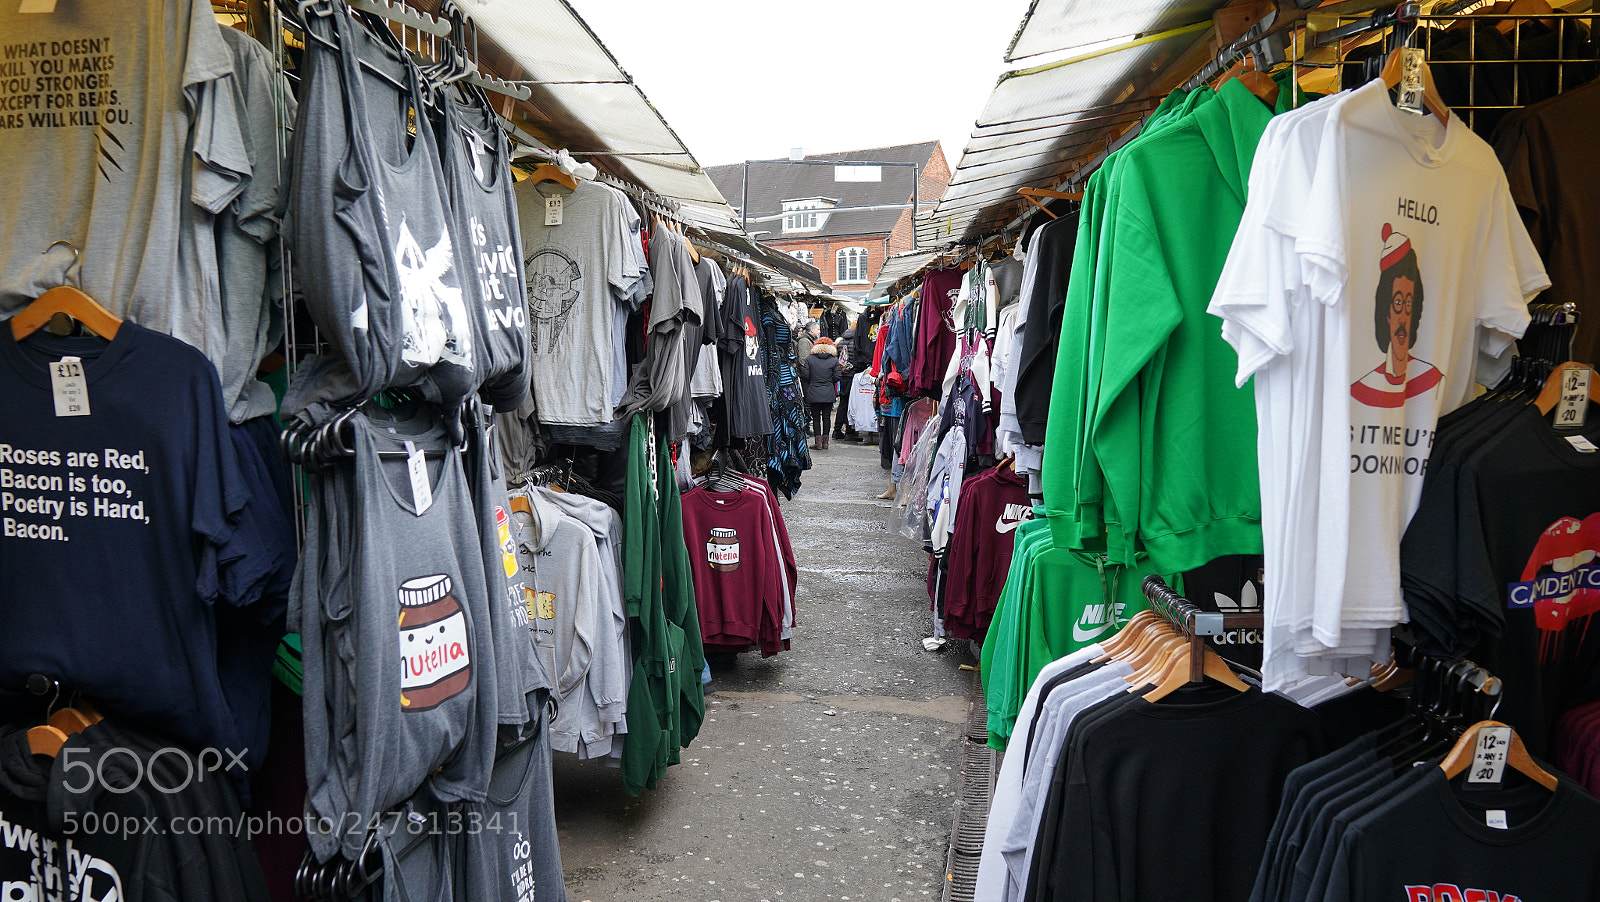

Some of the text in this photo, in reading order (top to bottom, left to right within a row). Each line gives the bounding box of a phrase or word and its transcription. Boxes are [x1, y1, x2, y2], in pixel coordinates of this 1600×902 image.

[4, 38, 110, 59] WHAT DOESN'T
[0, 55, 114, 77] KILL YOU MAKES
[1, 73, 113, 94] YOU STRONGER.
[46, 93, 74, 109] FOR
[28, 112, 66, 128] WILL
[69, 110, 101, 126] KILL
[102, 108, 133, 125] OU.
[1397, 196, 1440, 226] HELLO.
[57, 364, 80, 378] £12
[1360, 425, 1380, 445] IT
[1383, 426, 1402, 446] ME
[0, 443, 150, 475] Roses are Red,
[0, 468, 132, 499] Bacon is too,
[1, 491, 150, 525] Poetry is Hard,
[1002, 503, 1033, 521] NIKE
[3, 517, 69, 542] Bacon.
[709, 551, 739, 561] nutella
[1080, 602, 1127, 625] NIKE
[1483, 752, 1497, 761] ANY
